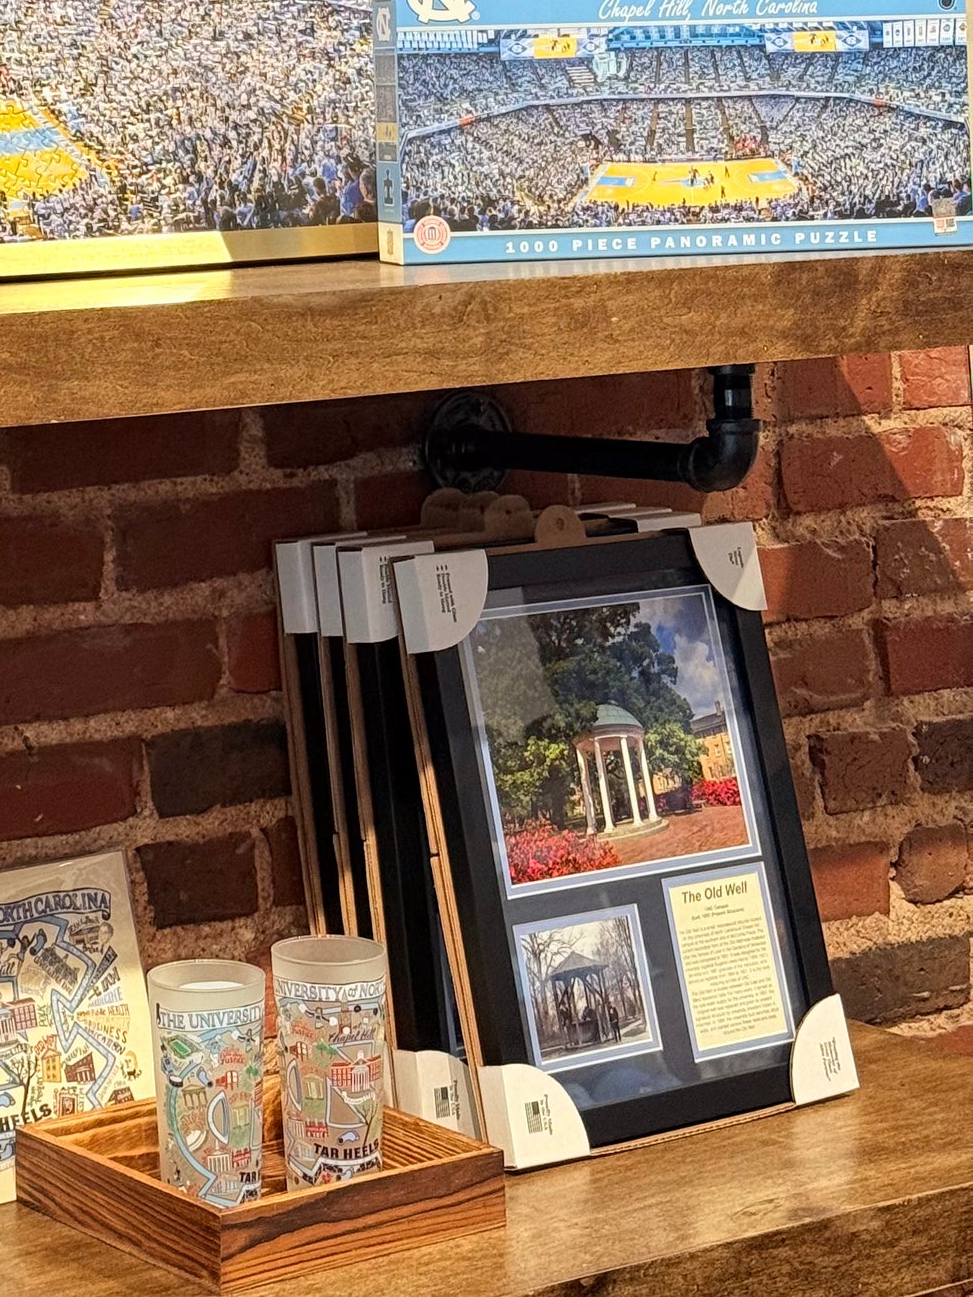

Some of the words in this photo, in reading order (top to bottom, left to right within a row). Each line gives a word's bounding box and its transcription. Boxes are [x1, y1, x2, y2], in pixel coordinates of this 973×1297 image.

[505, 240, 558, 254] 1000
[572, 237, 637, 251] PIECE
[650, 233, 781, 249] PANORAMIC
[795, 230, 877, 244] PUZZLE
[34, 892, 110, 915] CAROLINA
[682, 891, 702, 904] The
[704, 886, 723, 900] Old
[725, 881, 748, 896] Well
[276, 979, 342, 1001] NIVERSITY
[348, 986, 358, 998] of
[160, 1012, 185, 1029] THE
[187, 1005, 264, 1029] UNIVERSIT
[328, 1031, 358, 1046] Chapel
[360, 1027, 378, 1040] Hill
[0, 1104, 52, 1133] HEELS
[313, 1142, 339, 1160] TAR
[342, 1138, 380, 1160] HEELS
[239, 1171, 257, 1184] TAR
